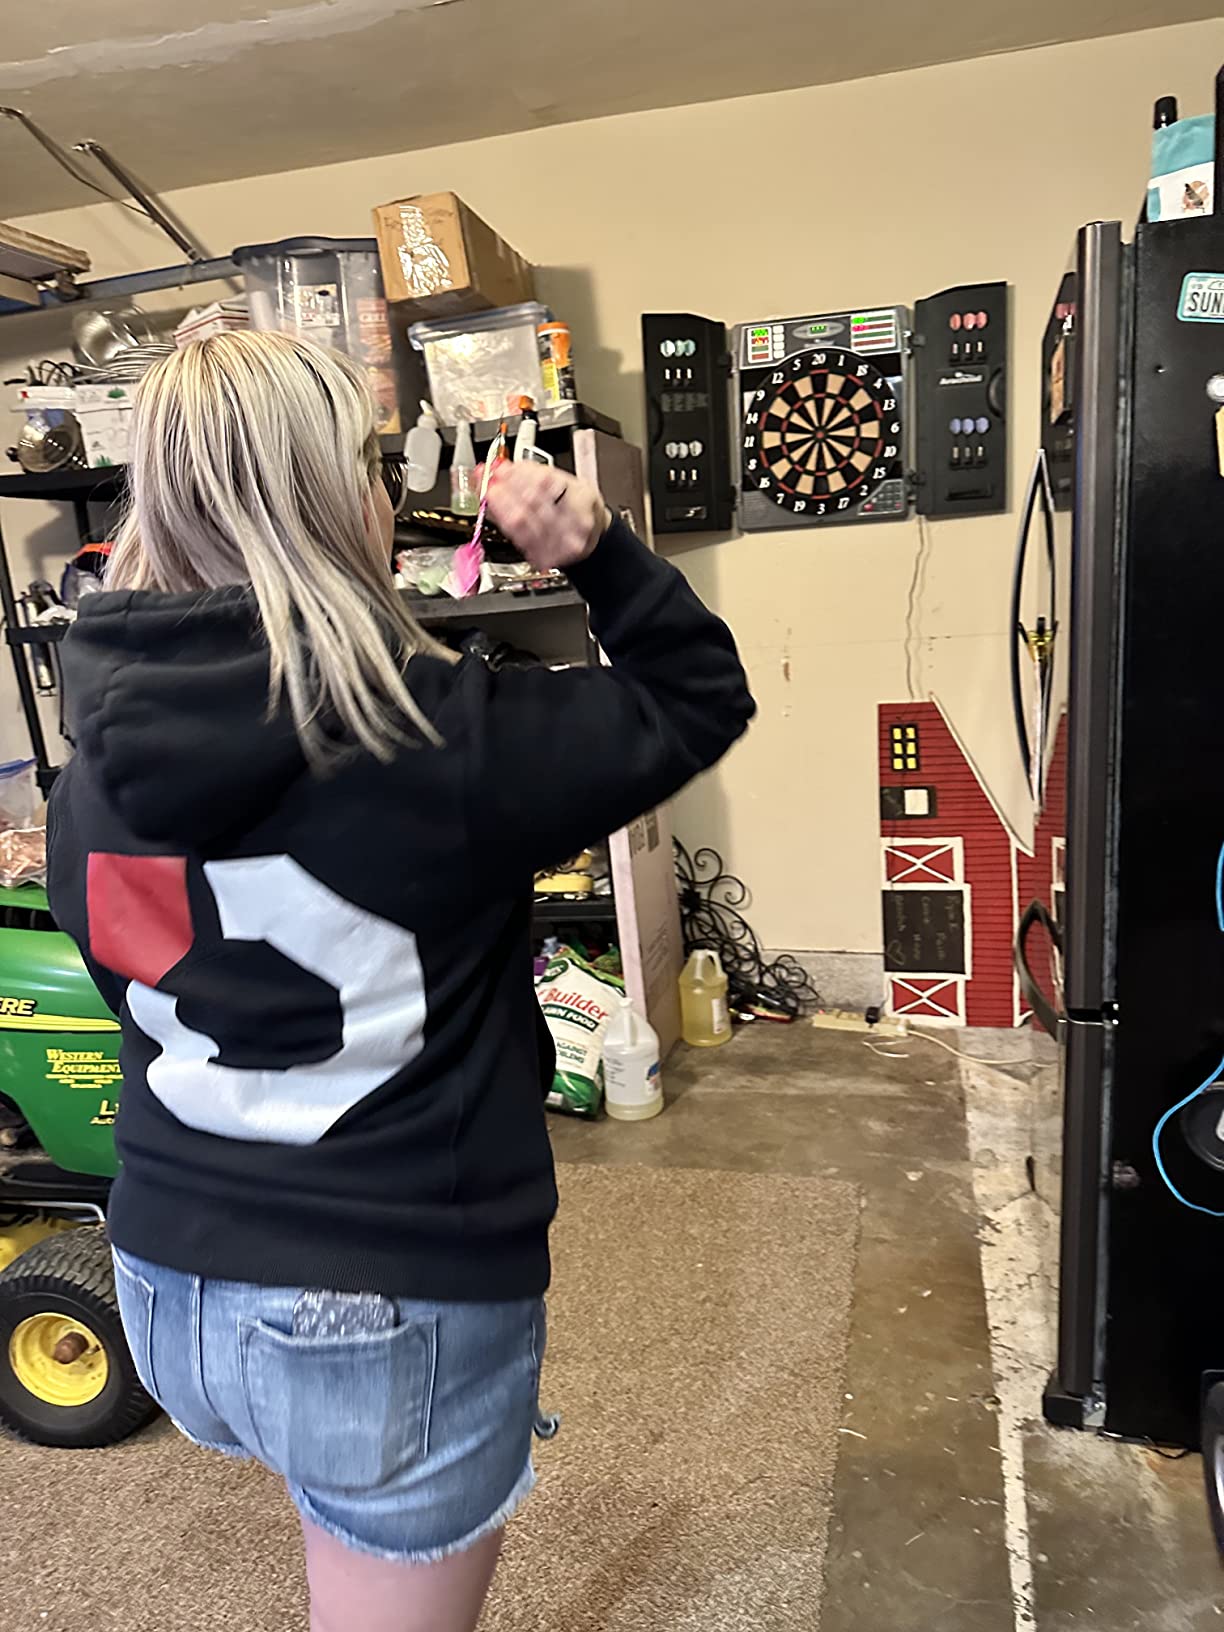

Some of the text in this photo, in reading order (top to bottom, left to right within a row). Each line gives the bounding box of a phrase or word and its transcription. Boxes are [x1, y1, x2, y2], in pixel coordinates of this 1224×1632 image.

[1188, 291, 1224, 313] SUN
[792, 359, 801, 371] 5
[811, 353, 826, 365] 20
[838, 354, 845, 366] 1
[772, 372, 784, 385] 12
[873, 378, 882, 389] 4
[756, 390, 765, 401] 9
[883, 399, 896, 411] 13
[746, 412, 759, 425] 14
[890, 422, 900, 433] 6
[744, 436, 755, 448] 11
[884, 446, 897, 458] 10
[748, 459, 757, 470] 8
[873, 467, 886, 479] 15
[759, 477, 771, 488] 16
[859, 485, 869, 496] 2
[776, 493, 784, 504] 7
[837, 497, 850, 509] 17
[793, 501, 806, 512] 19
[817, 503, 825, 515] 3
[0, 997, 36, 1013] RE
[543, 988, 609, 1020] Builder
[566, 1012, 596, 1028] FOOD
